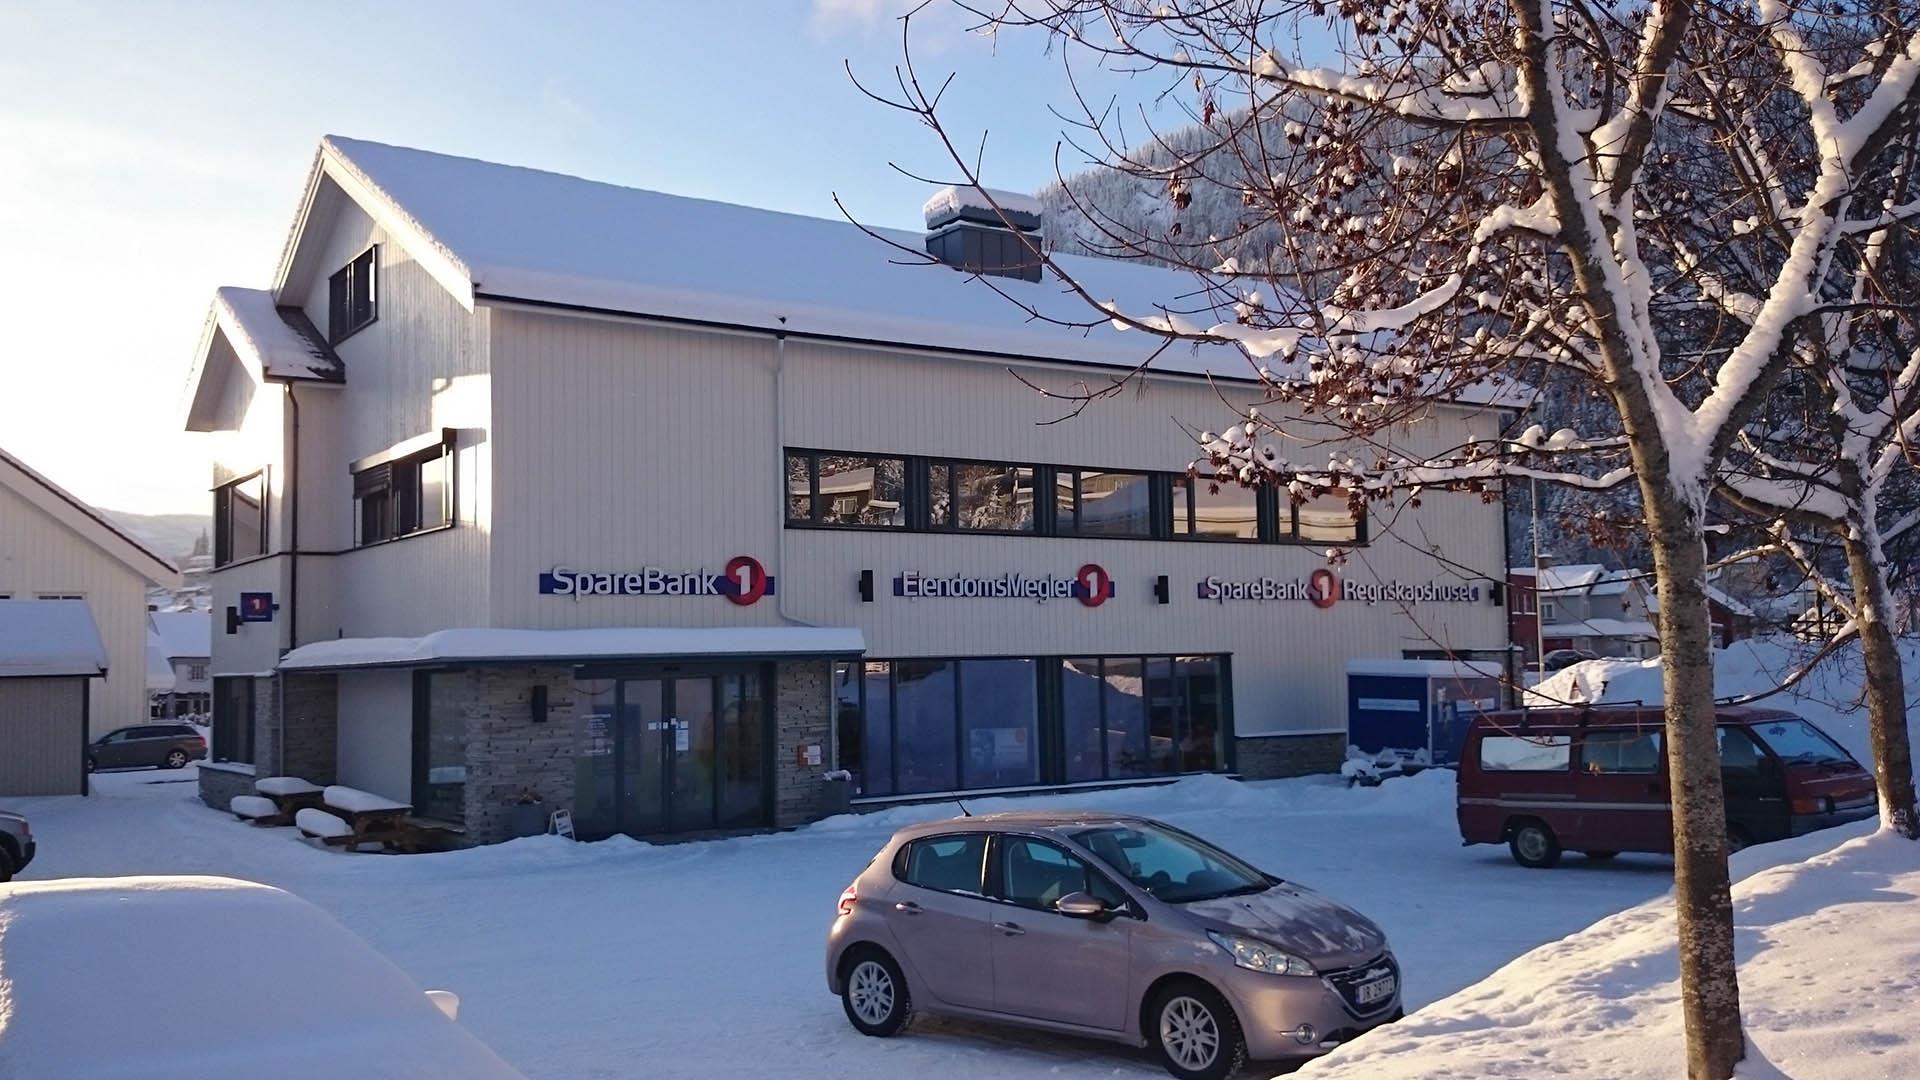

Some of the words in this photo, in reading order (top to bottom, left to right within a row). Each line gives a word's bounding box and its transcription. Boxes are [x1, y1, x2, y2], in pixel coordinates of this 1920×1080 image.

[552, 566, 719, 602] SpareBank
[735, 564, 752, 596] 1
[902, 571, 1077, 604] EiendomsMegler
[1085, 571, 1098, 599] 1
[1207, 576, 1310, 604] SpareBank
[1318, 576, 1330, 601] 1
[1342, 579, 1475, 606] Regnskapshuset
